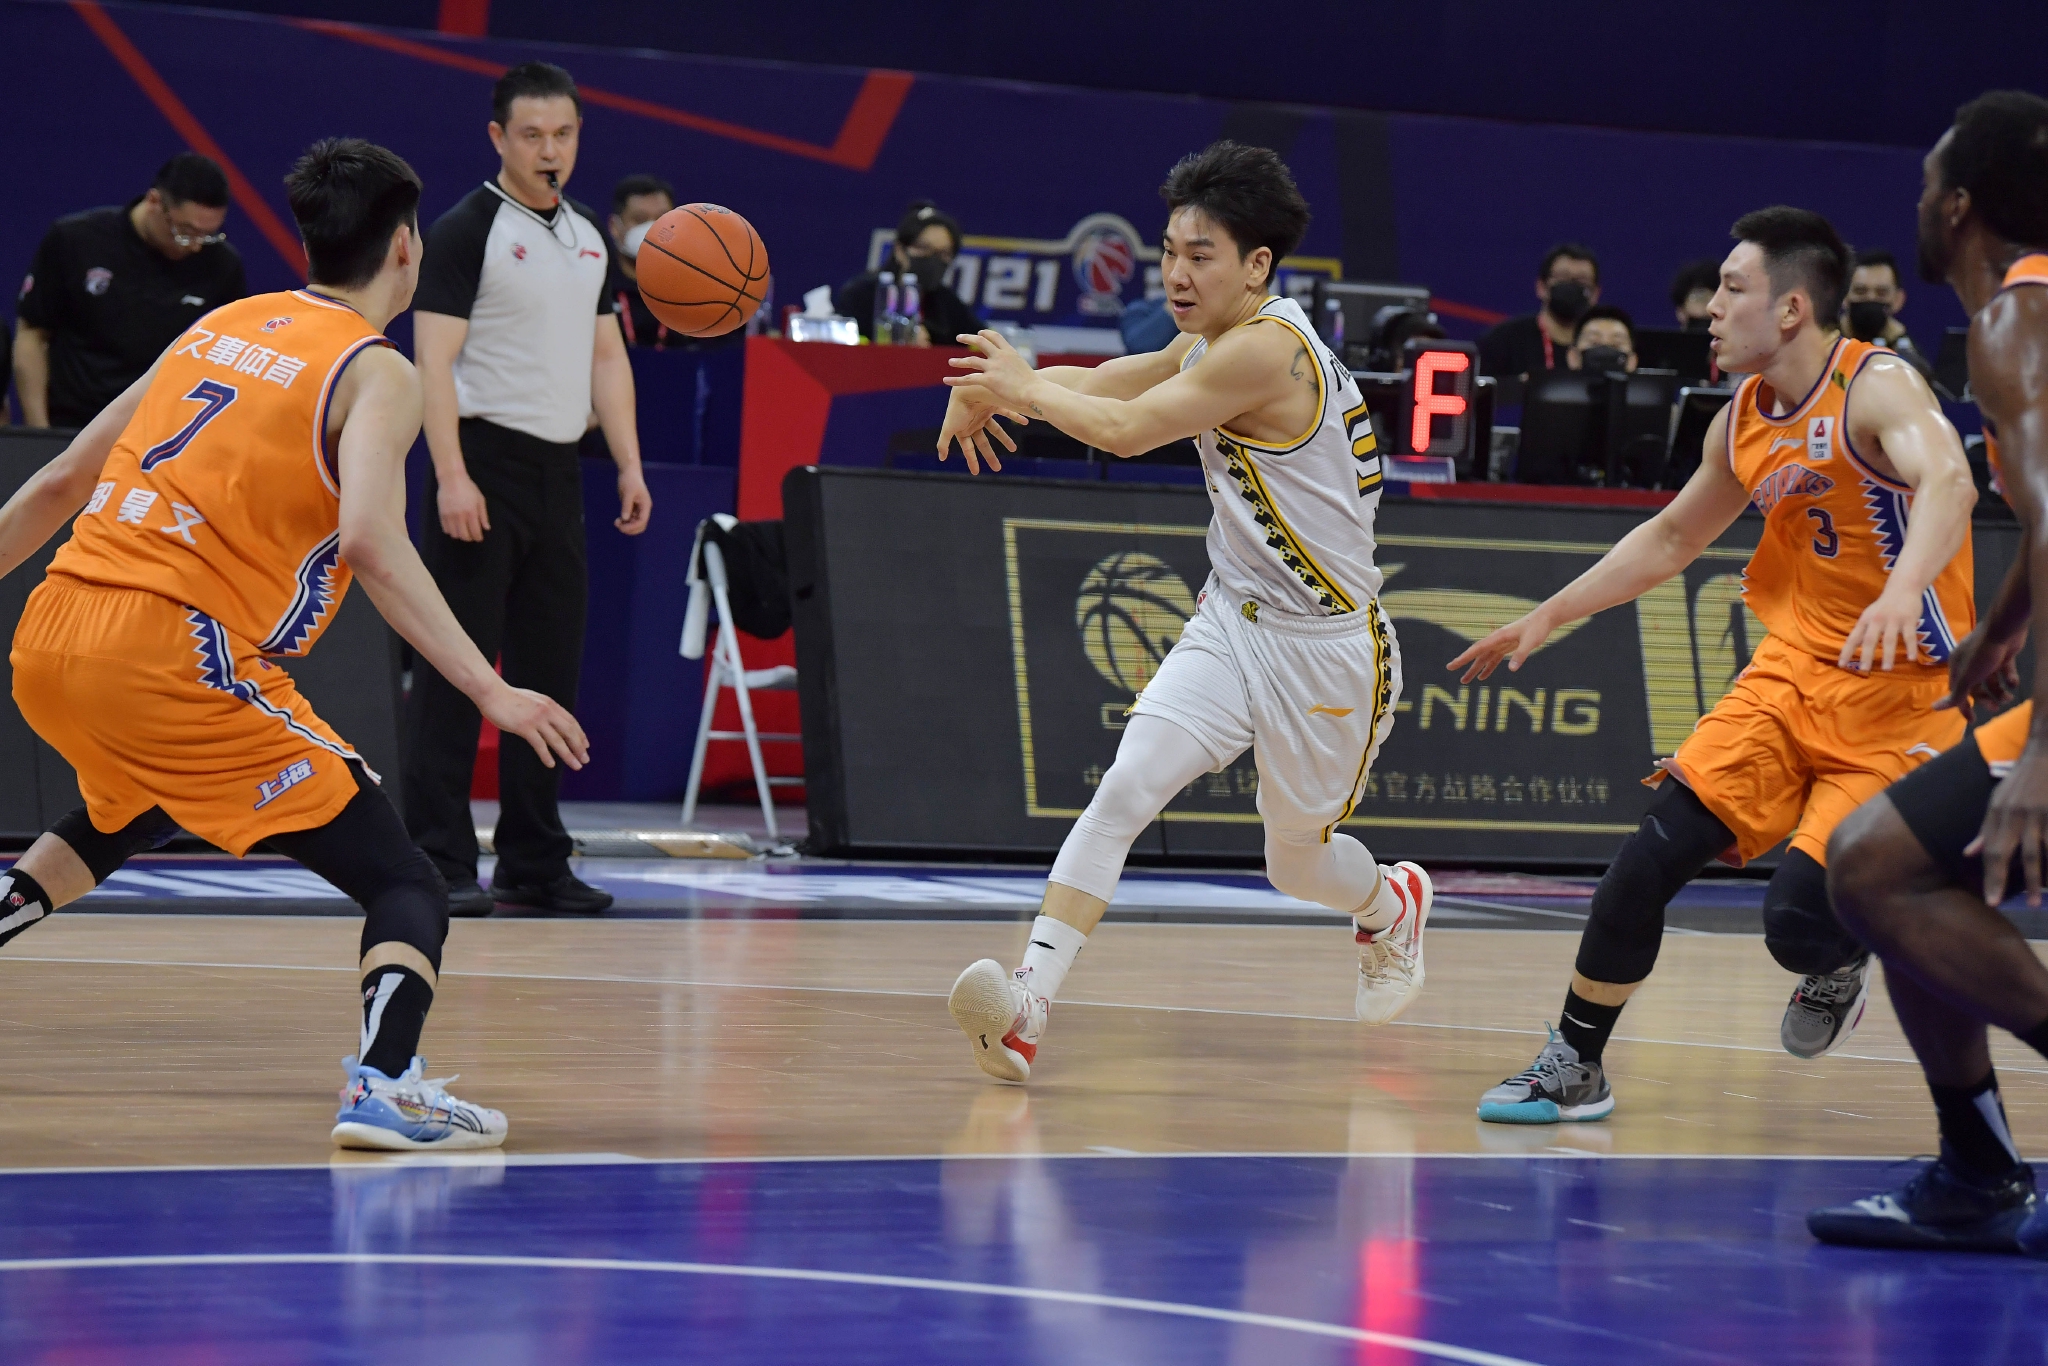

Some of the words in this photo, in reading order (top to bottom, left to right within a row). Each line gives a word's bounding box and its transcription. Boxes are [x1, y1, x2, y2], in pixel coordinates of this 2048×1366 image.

[941, 253, 1060, 313] 021
[175, 326, 308, 390] 久事体育
[140, 377, 238, 474] 7
[1411, 350, 1469, 453] F
[1806, 507, 1840, 559] 3
